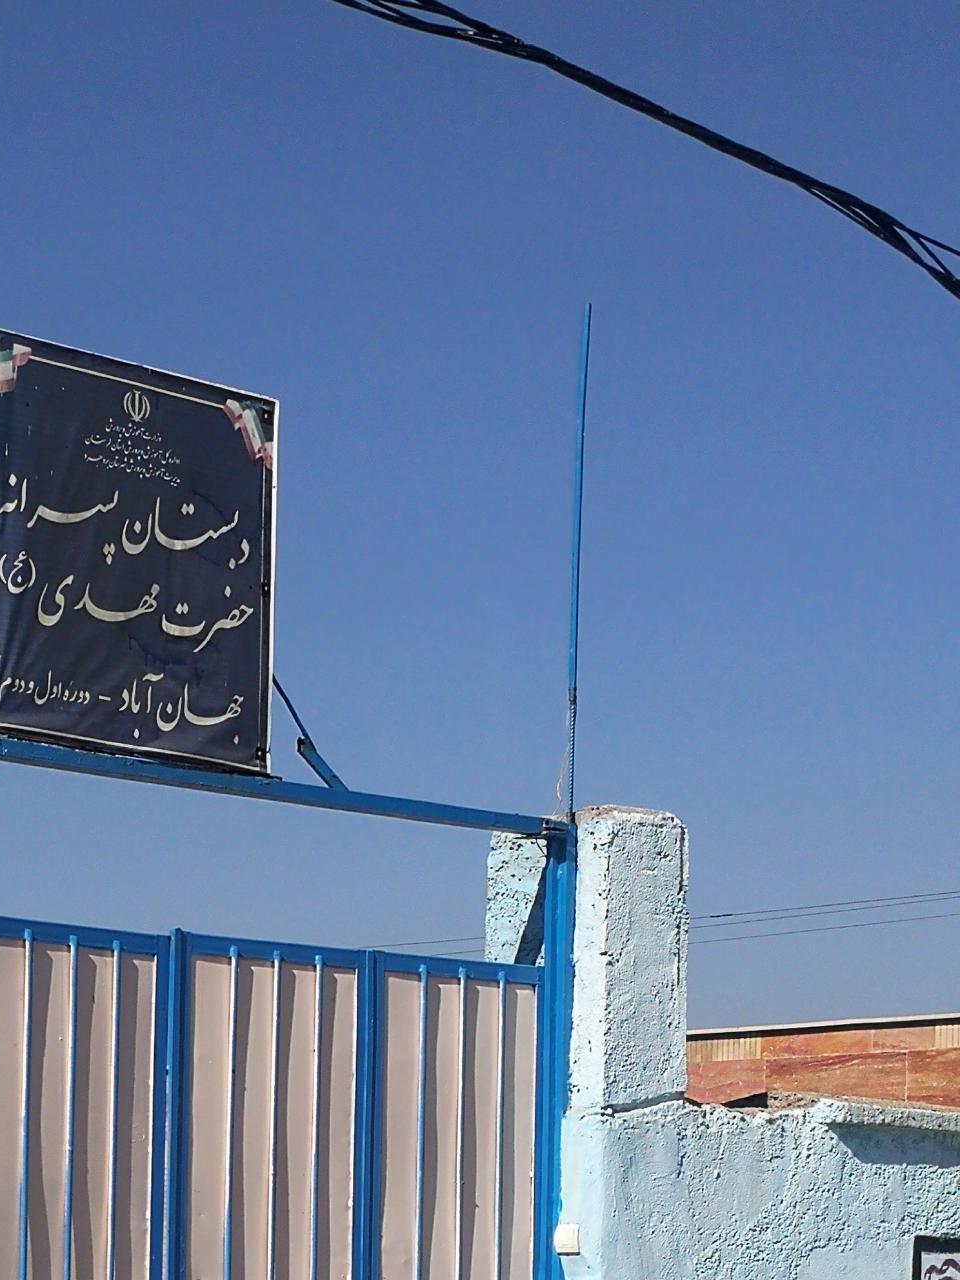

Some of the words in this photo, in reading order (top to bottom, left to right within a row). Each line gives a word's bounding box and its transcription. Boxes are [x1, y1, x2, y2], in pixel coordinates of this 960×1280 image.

[105, 418, 123, 439] پرورش
[124, 423, 145, 437] آموزش
[84, 434, 113, 448] لرستان
[110, 438, 125, 452] استان
[124, 440, 142, 461] پرورش
[142, 445, 164, 460] آموزش
[126, 458, 143, 479] پرورش
[145, 463, 166, 478] آموزش
[122, 497, 250, 570] دبستان
[37, 574, 160, 627] مهدی
[161, 585, 254, 653] حضرت
[25, 681, 35, 694] و
[34, 669, 62, 705] اول
[118, 672, 165, 739] آباد
[156, 683, 245, 745] جهان
